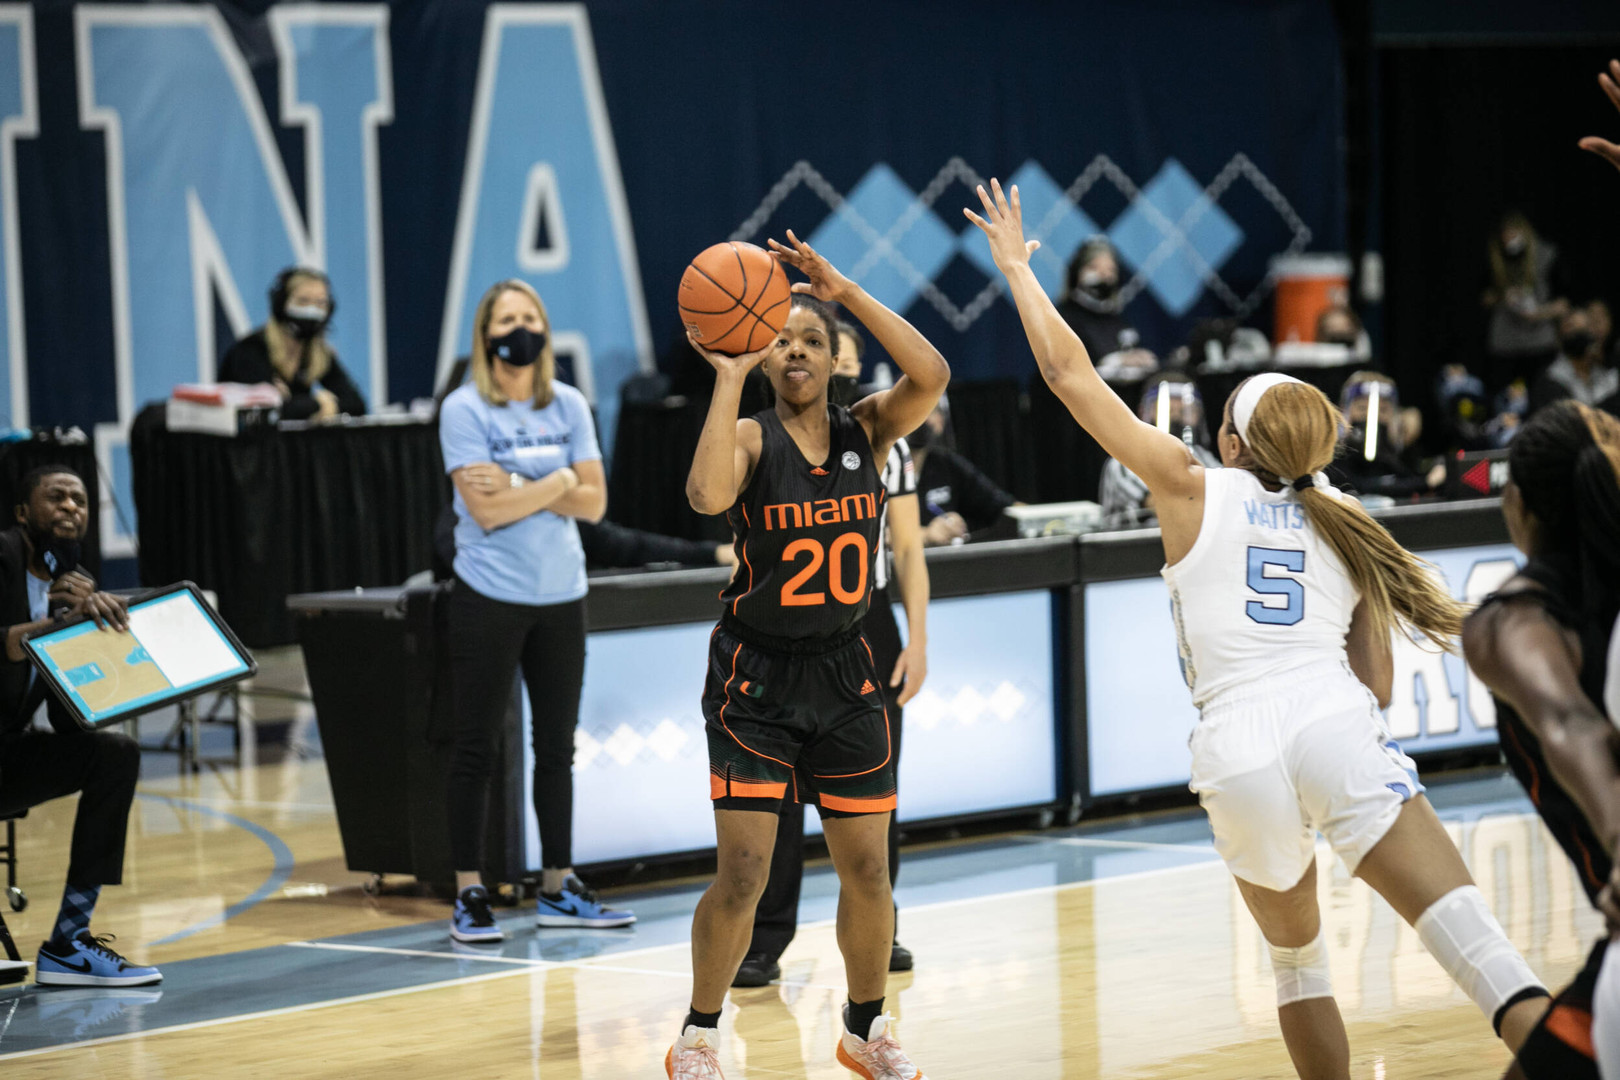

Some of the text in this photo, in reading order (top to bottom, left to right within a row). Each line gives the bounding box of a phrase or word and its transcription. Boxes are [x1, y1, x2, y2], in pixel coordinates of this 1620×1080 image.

[0, 4, 655, 560] NA
[1244, 499, 1304, 529] WATTS
[780, 532, 868, 606] 20
[1246, 545, 1305, 626] 5
